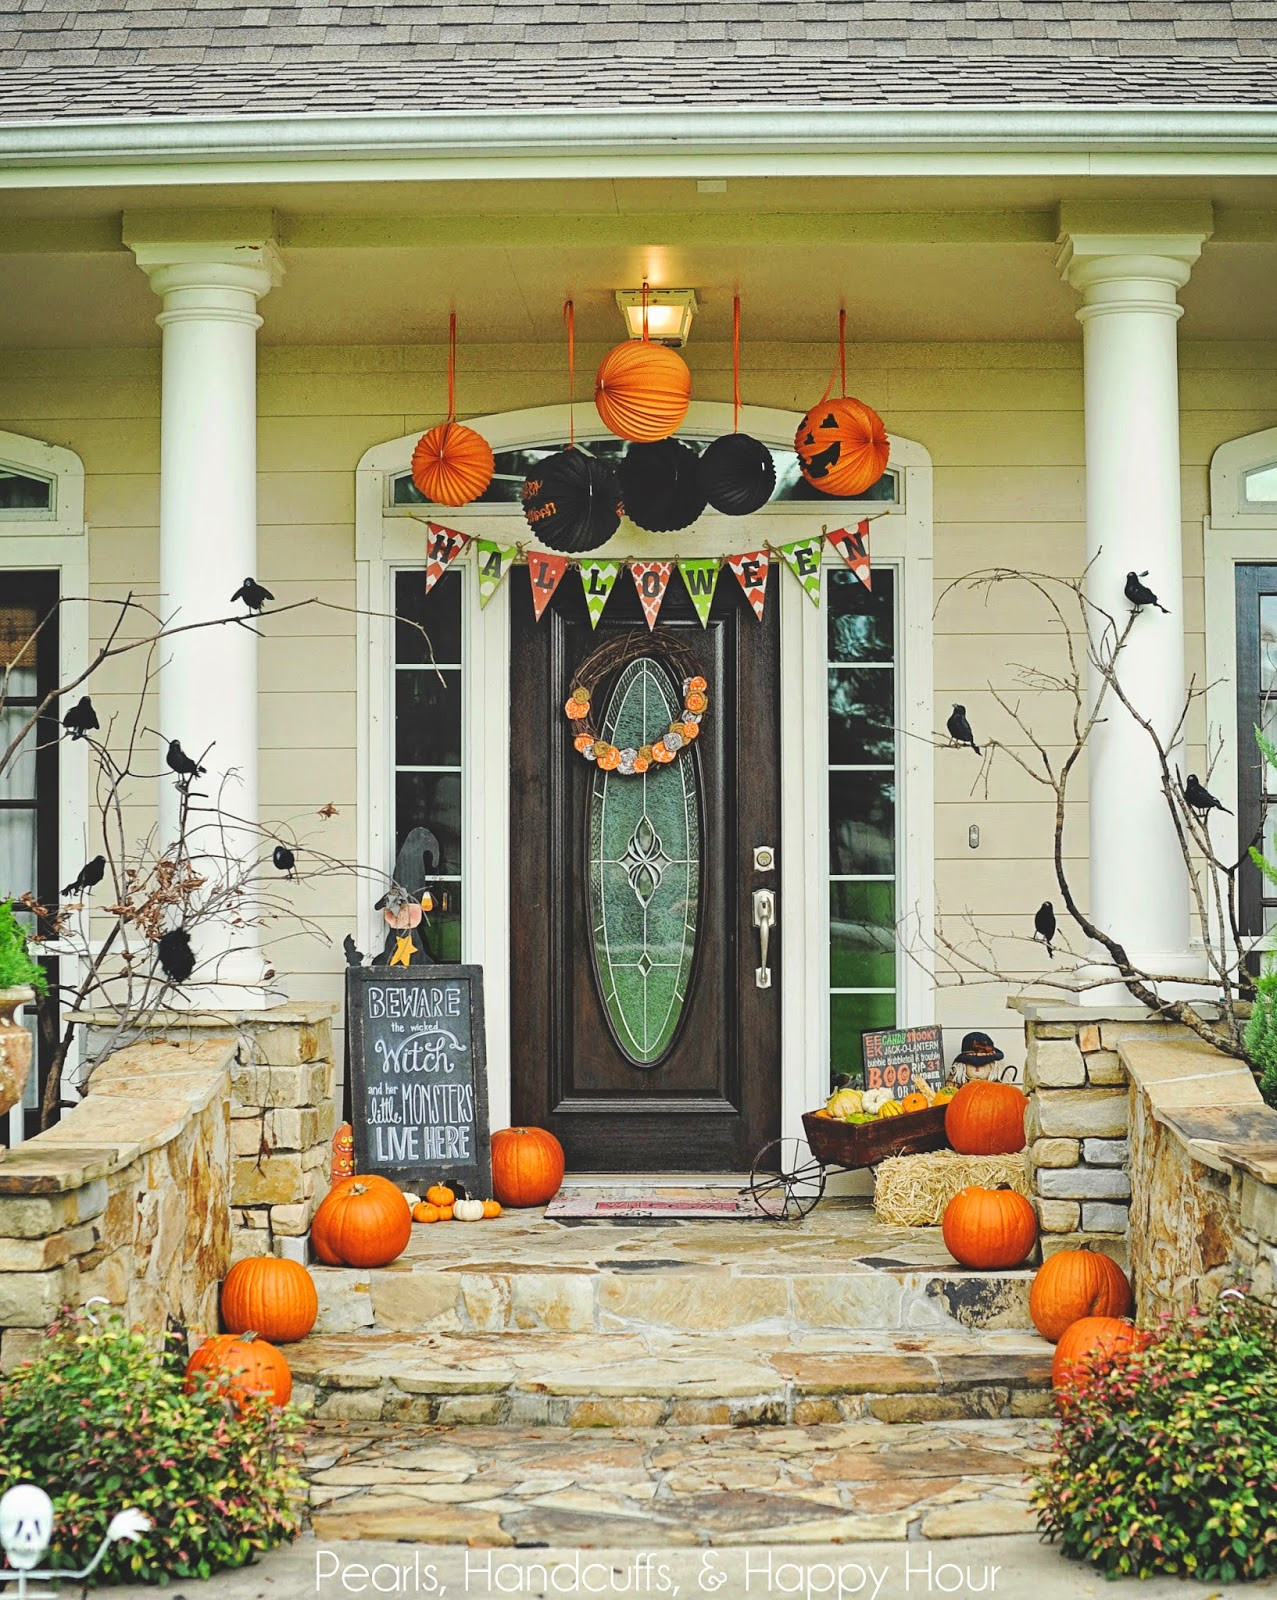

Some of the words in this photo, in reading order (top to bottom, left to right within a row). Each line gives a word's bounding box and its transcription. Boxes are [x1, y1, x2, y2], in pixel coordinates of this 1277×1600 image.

[428, 532, 869, 598] HALLOWEEN
[368, 987, 461, 1018] BEWARE
[391, 1021, 405, 1033] the
[410, 1020, 439, 1032] wicked
[882, 1032, 906, 1046] CANDY
[374, 1029, 467, 1073] Witch
[883, 1040, 939, 1056] JACK-O-LANTERN
[367, 1082, 382, 1096] and
[385, 1082, 399, 1095] her
[868, 1063, 911, 1089] BOO
[911, 1061, 926, 1073] RIP
[927, 1060, 941, 1071] 31
[367, 1096, 402, 1124] little
[402, 1083, 473, 1125] MONSTERS
[376, 1126, 419, 1161] LIVE
[424, 1126, 470, 1160] HERE
